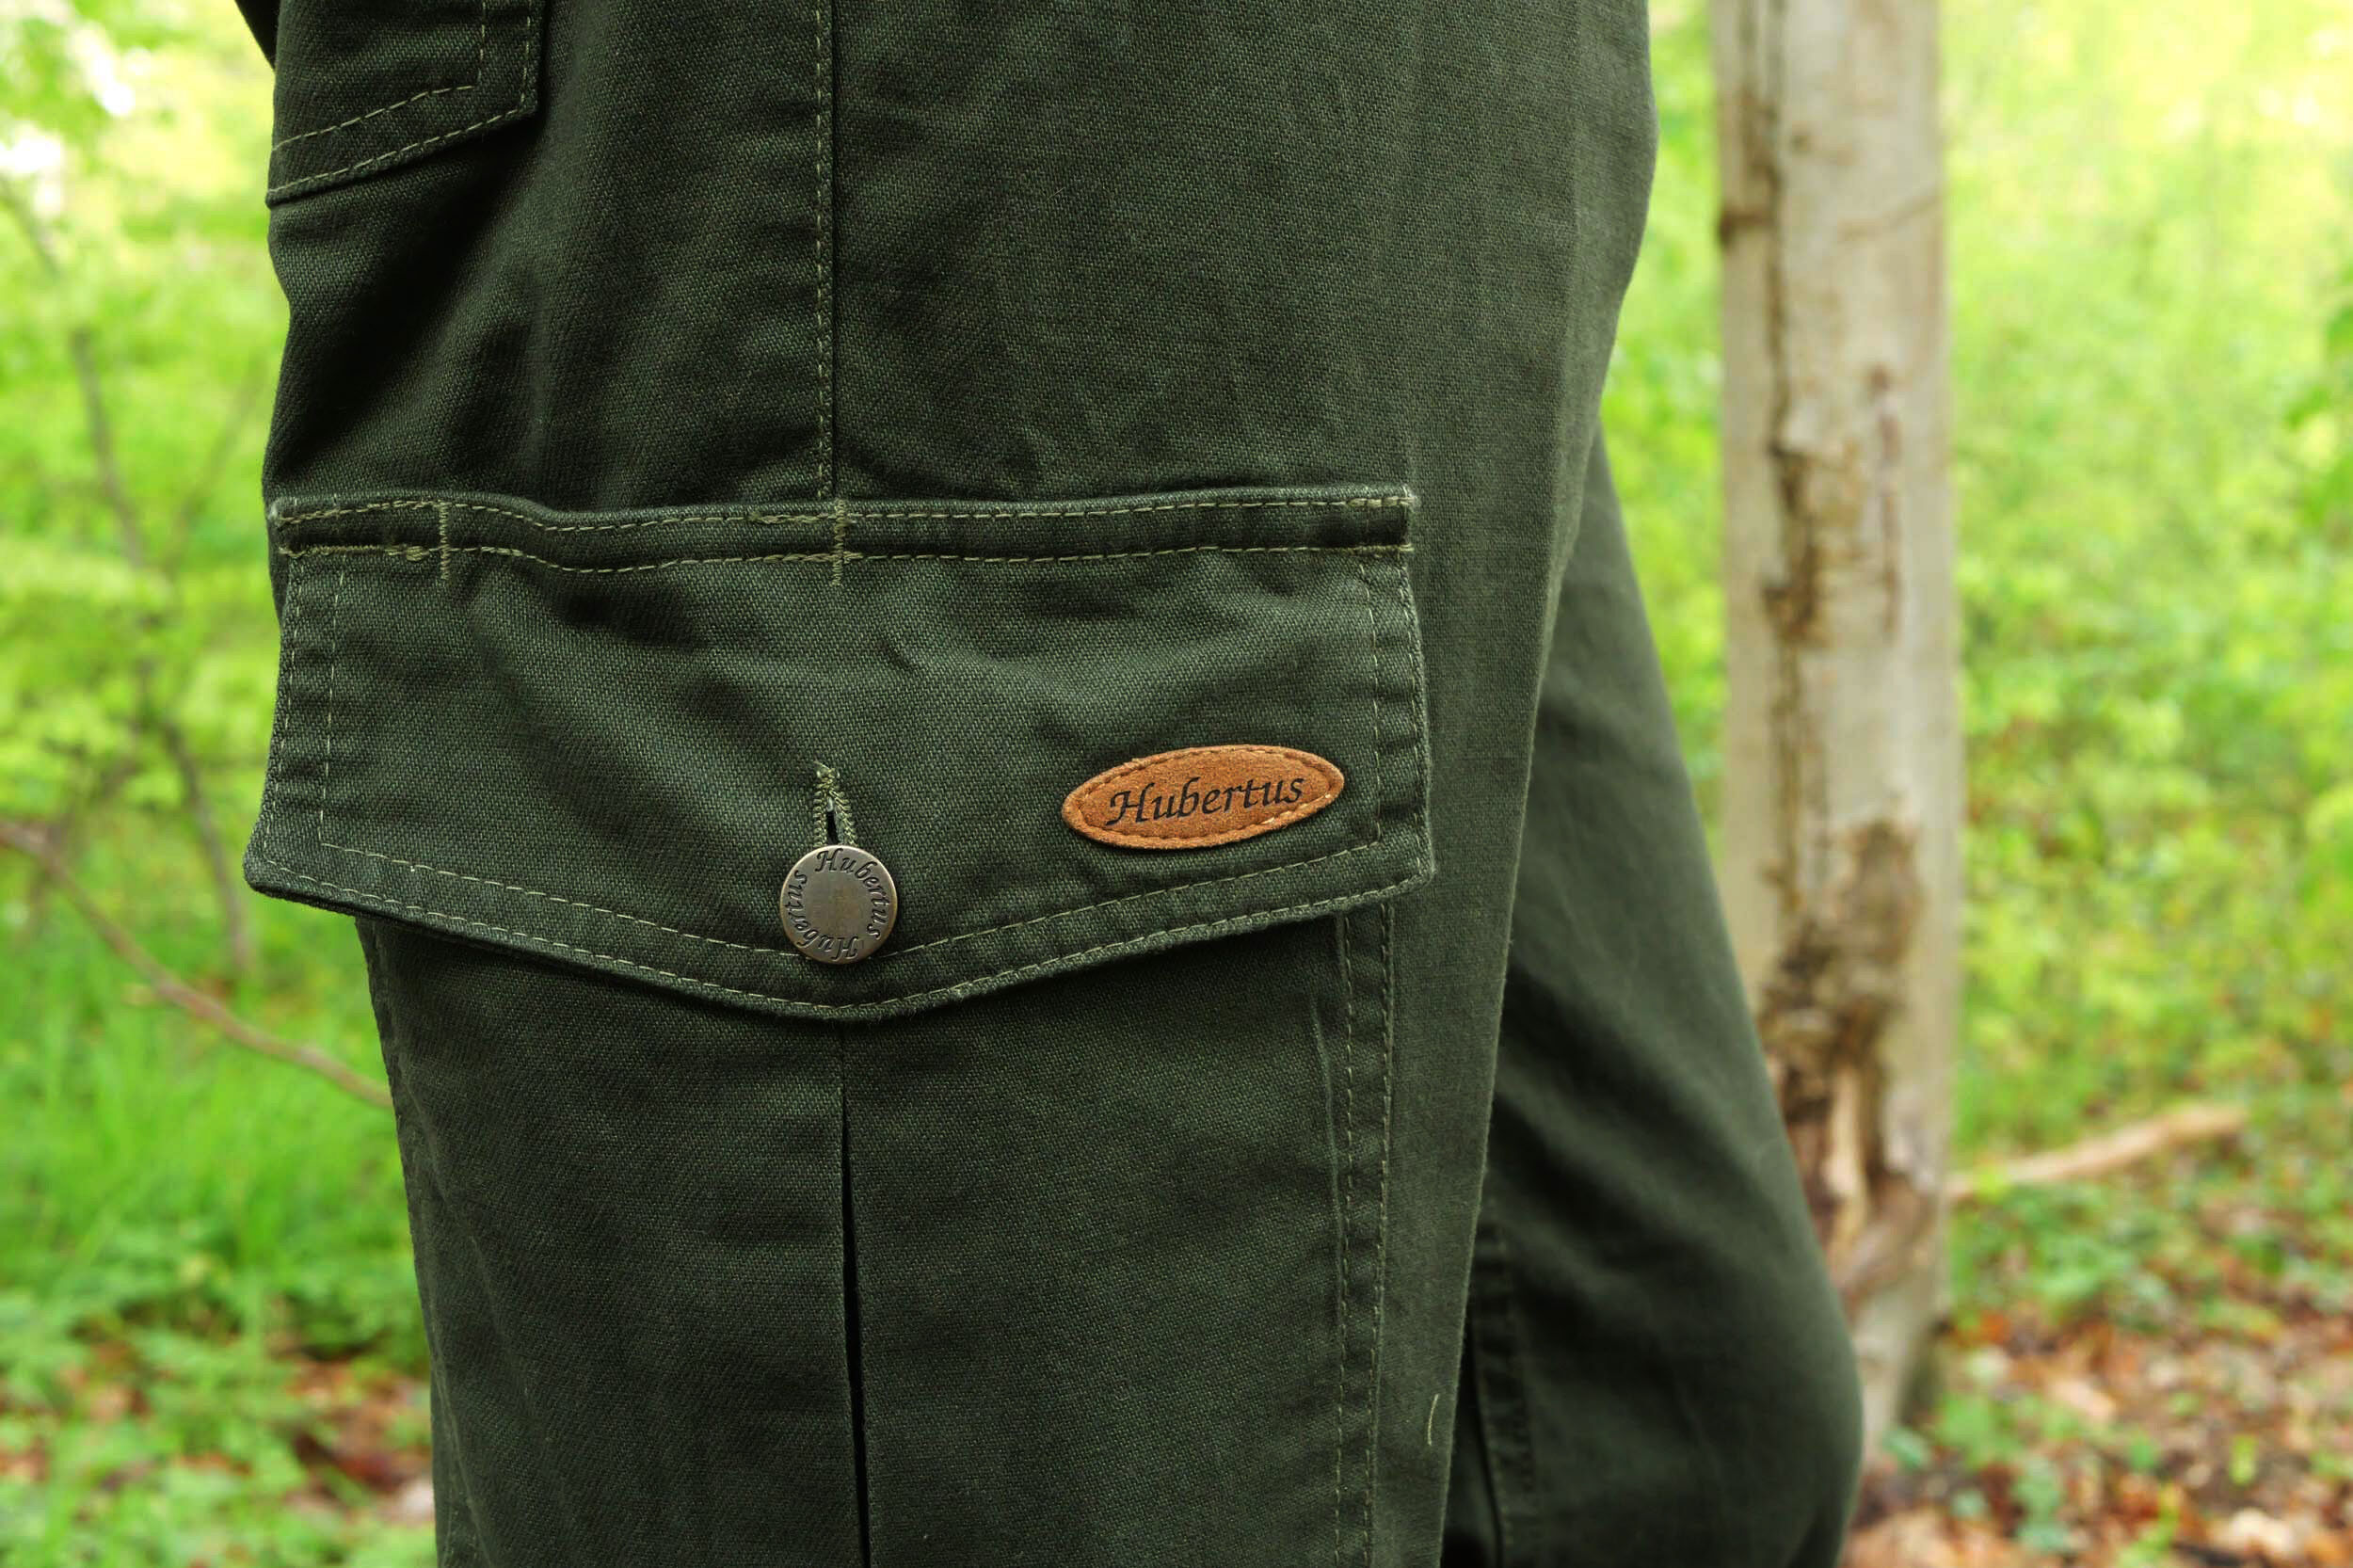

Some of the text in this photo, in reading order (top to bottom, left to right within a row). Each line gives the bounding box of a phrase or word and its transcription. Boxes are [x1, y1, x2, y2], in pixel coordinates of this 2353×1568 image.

[1105, 776, 1305, 826] Hubertus
[785, 870, 859, 960] Hubertus
[814, 848, 890, 939] Hubertus
